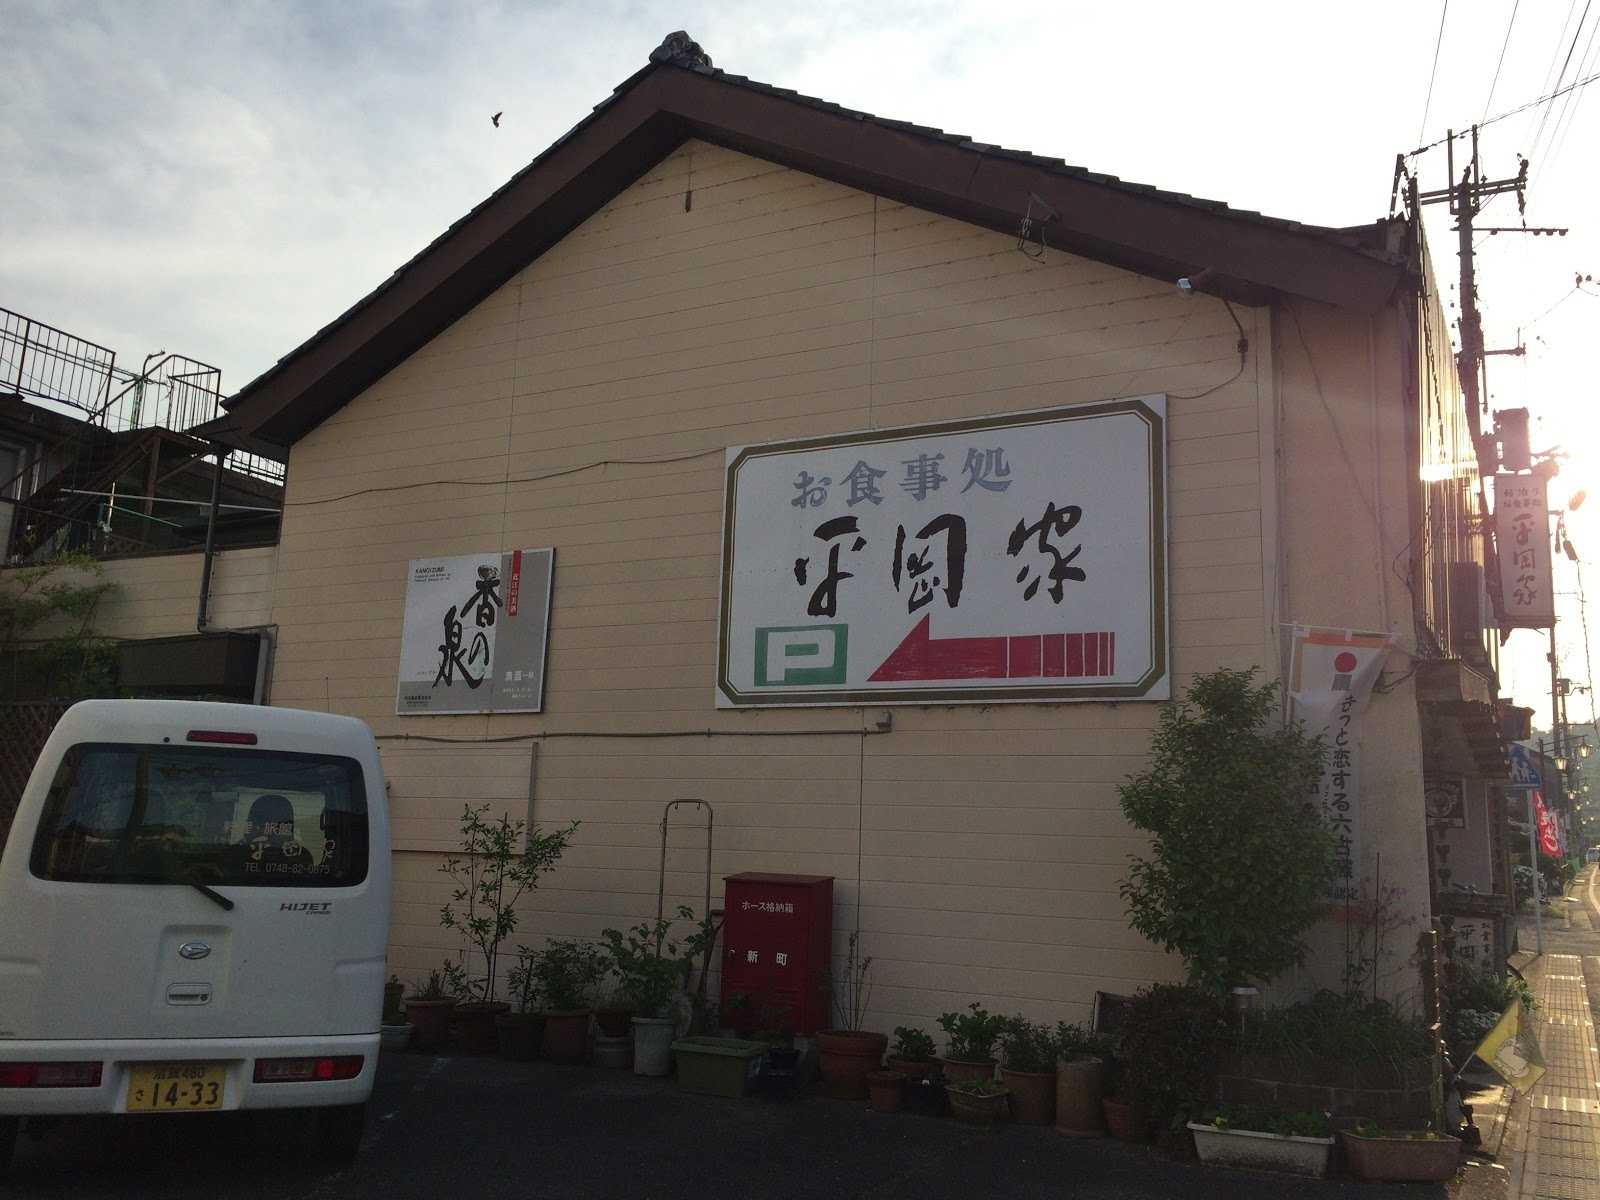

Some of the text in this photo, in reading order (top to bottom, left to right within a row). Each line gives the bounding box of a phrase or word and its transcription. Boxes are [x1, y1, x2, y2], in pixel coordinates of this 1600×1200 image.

[791, 447, 1013, 508] お食事処
[766, 628, 837, 683] P
[245, 862, 261, 873] TEL
[279, 902, 333, 911] HIJET
[742, 901, 794, 913] ホース格納箱
[152, 1082, 220, 1107] 14-33
